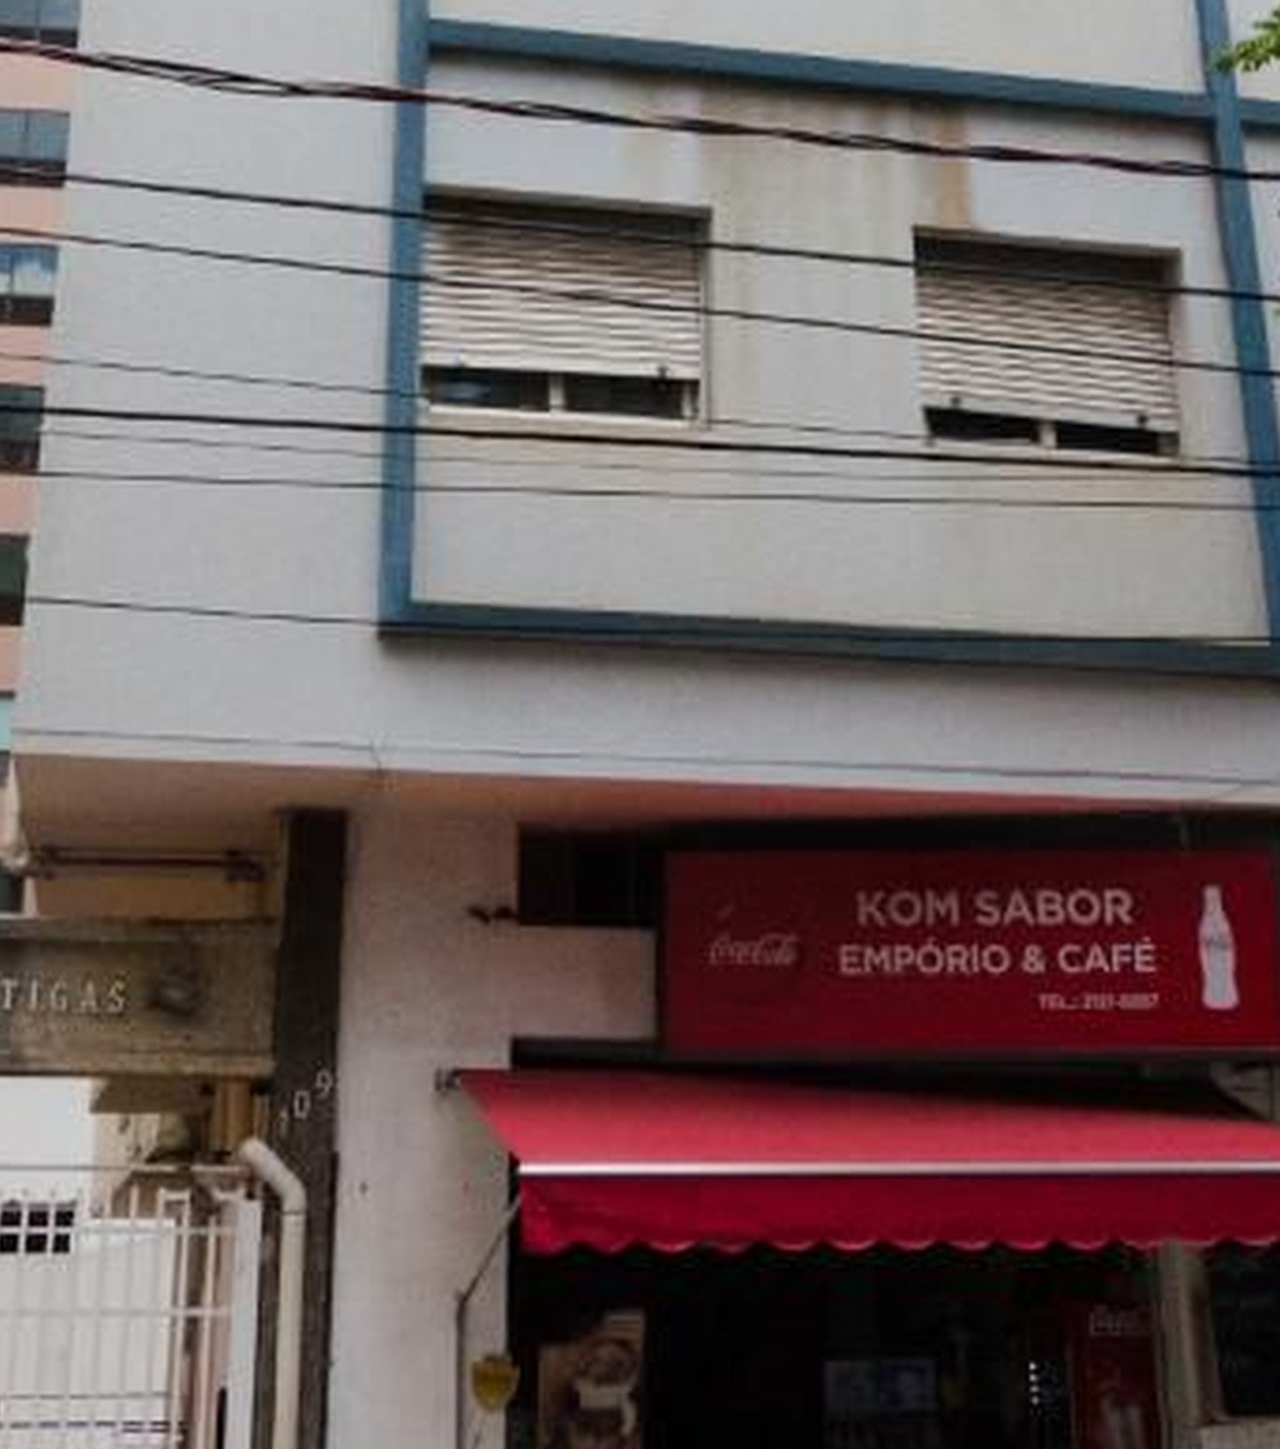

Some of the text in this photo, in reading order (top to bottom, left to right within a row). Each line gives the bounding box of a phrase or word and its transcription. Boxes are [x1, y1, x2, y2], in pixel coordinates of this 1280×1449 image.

[855, 890, 1134, 928] KOM SABOR
[837, 936, 1156, 976] EMPÓRIO & CAFÉ
